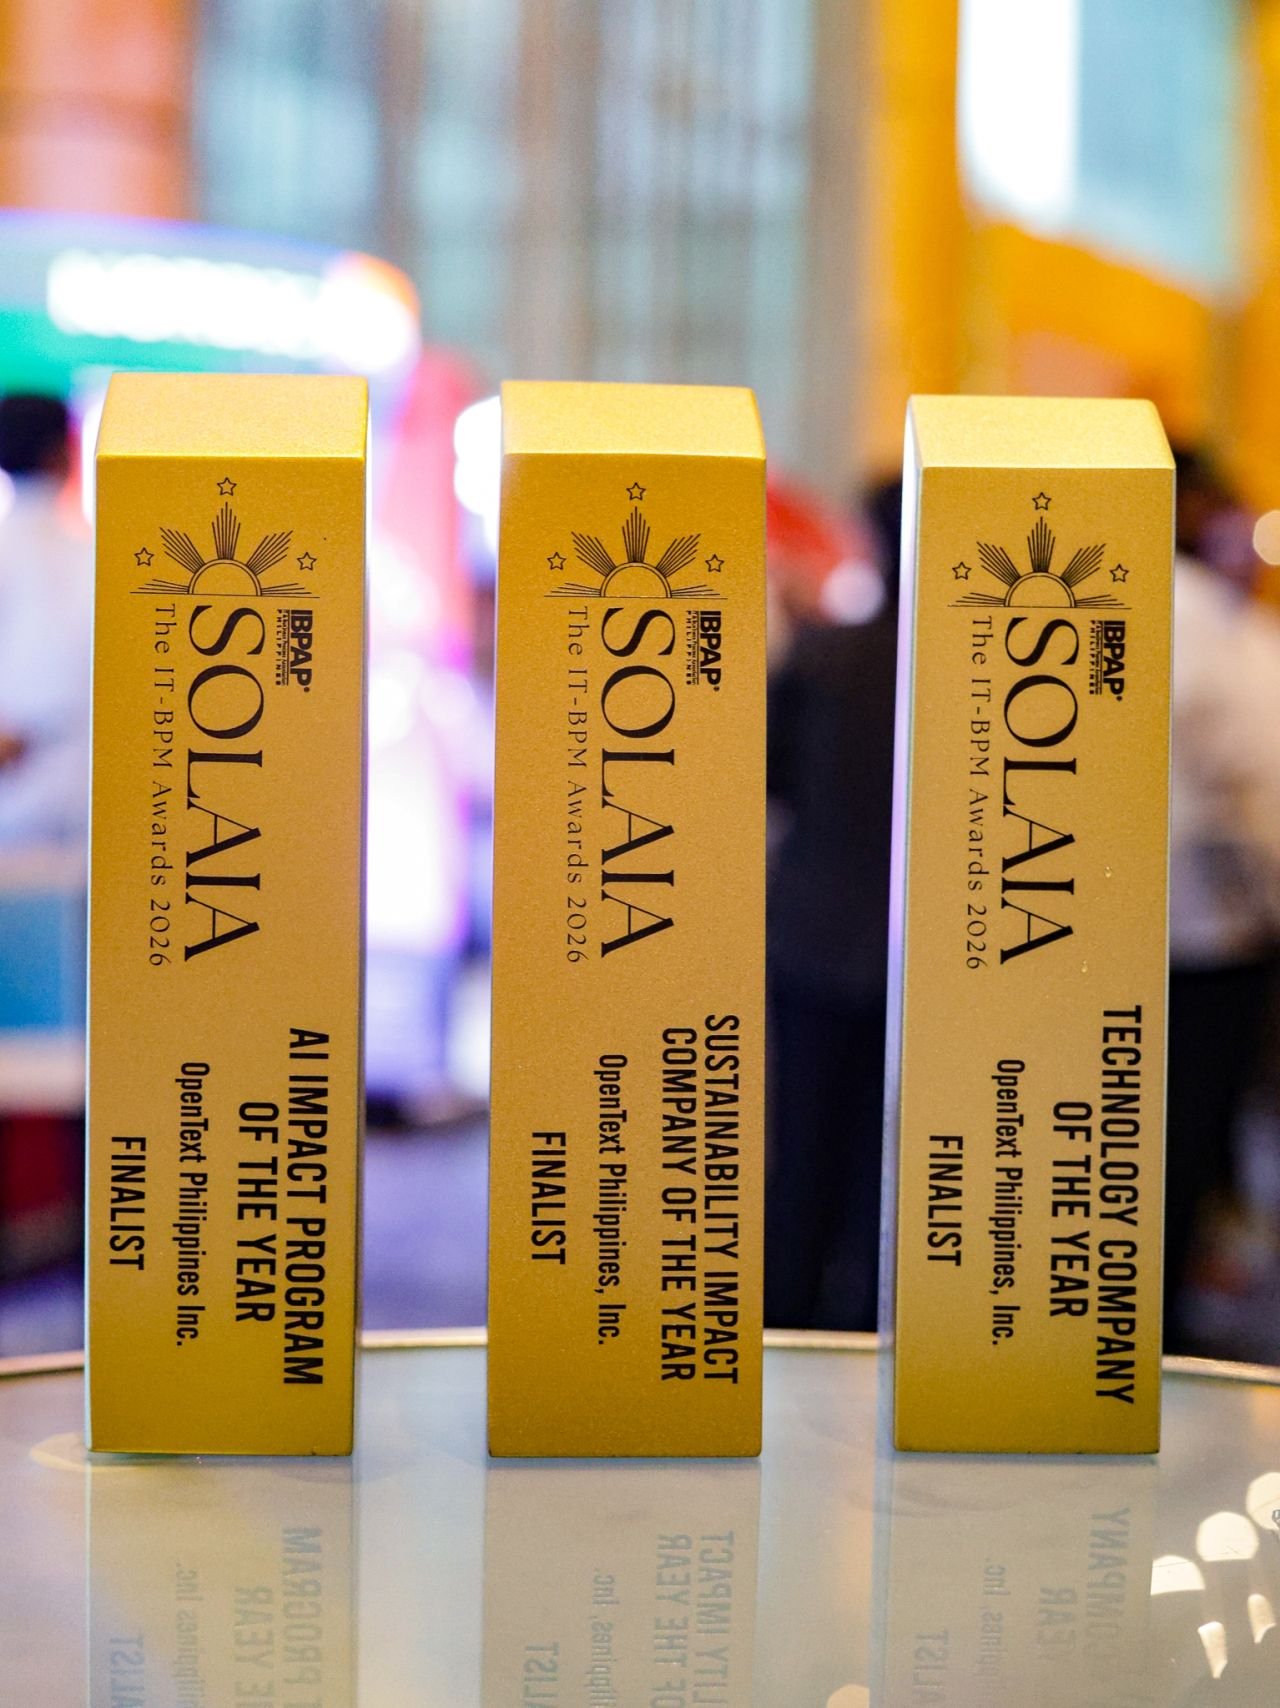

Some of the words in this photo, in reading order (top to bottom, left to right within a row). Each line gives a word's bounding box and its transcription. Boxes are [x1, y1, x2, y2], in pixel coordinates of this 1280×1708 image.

[154, 603, 178, 654] The
[567, 605, 591, 656] The
[971, 615, 994, 665] The
[152, 667, 175, 768] IT-BPM
[567, 669, 588, 767] IT-BPM
[969, 678, 991, 776] IT-BPM
[150, 780, 174, 886] Awards
[184, 605, 266, 963] SOLAIA
[567, 780, 590, 884] Awards
[600, 607, 676, 959] SOLAIA
[1000, 616, 1080, 965] SOLAIA
[967, 788, 990, 891] Awards
[148, 898, 171, 967] 2026
[566, 896, 588, 963] 2026
[966, 903, 988, 970] 2026
[288, 1027, 330, 1060] AI
[174, 1062, 211, 1164] OpenText
[238, 1101, 280, 1145] OF
[286, 1075, 329, 1205] IMPACT
[593, 1054, 629, 1155] OpenText
[661, 1027, 698, 1176] COMPANY
[703, 1014, 741, 1260] SUSTAINABILITY
[990, 1059, 1026, 1159] OpenText
[1052, 1101, 1094, 1143] OF
[1098, 1004, 1143, 1227] TECHNOLOGY
[108, 1136, 147, 1271] FINALIST
[171, 1172, 209, 1297] Philippines
[236, 1155, 279, 1221] THE
[530, 1131, 567, 1265] FINALIST
[592, 1163, 628, 1294] Philippines,
[660, 1187, 697, 1224] OF
[926, 1135, 964, 1267] FINALIST
[988, 1166, 1024, 1296] Philippines,
[1051, 1154, 1092, 1219] THE
[235, 1233, 277, 1322] YEAR
[283, 1217, 327, 1385] PROGRAM
[661, 1234, 697, 1292] THE
[1049, 1230, 1091, 1317] YEAR
[175, 1305, 206, 1347] Inc.
[597, 1303, 627, 1345] Inc.
[660, 1302, 697, 1381] YEAR
[703, 1271, 739, 1385] IMPACT
[991, 1305, 1021, 1346] Inc.
[1095, 1239, 1138, 1405] COMPANY
